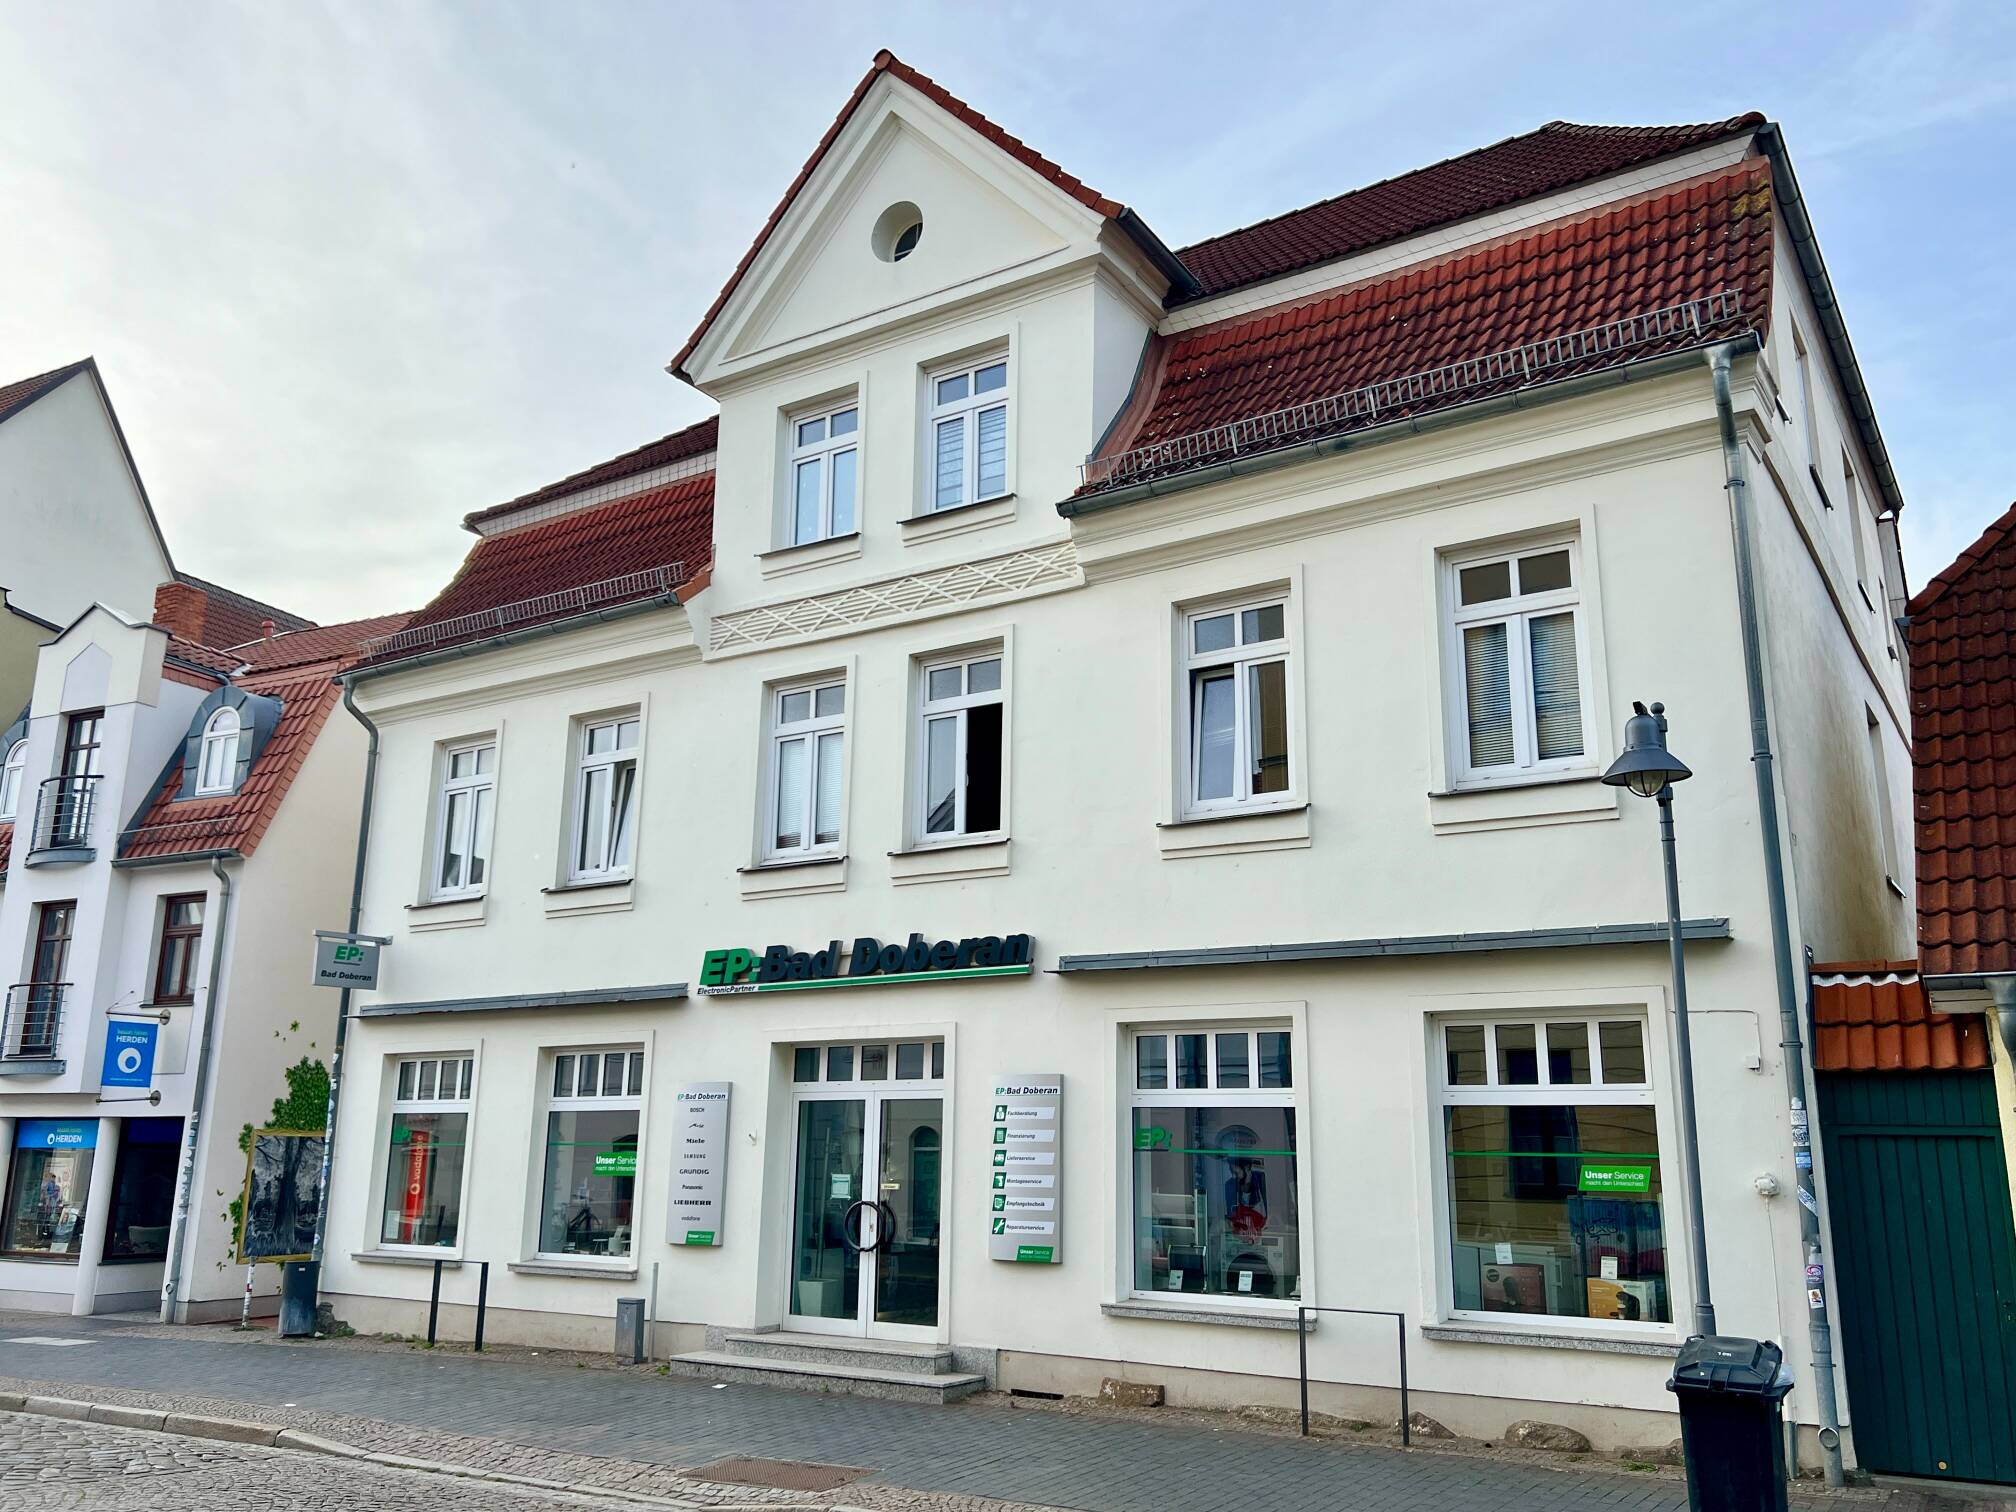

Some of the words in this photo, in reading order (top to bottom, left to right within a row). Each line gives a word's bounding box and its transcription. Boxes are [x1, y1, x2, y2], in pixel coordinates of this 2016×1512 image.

[335, 945, 364, 961] EP:
[851, 933, 1034, 976] Doberan
[339, 971, 372, 981] Doberan
[697, 985, 756, 994] ElectronicPartner
[116, 1035, 148, 1044] HERDEN
[55, 1134, 82, 1143] HERDEN
[596, 1155, 616, 1164] Unser
[1585, 1171, 1612, 1179] Unser
[1614, 1171, 1644, 1180] Service
